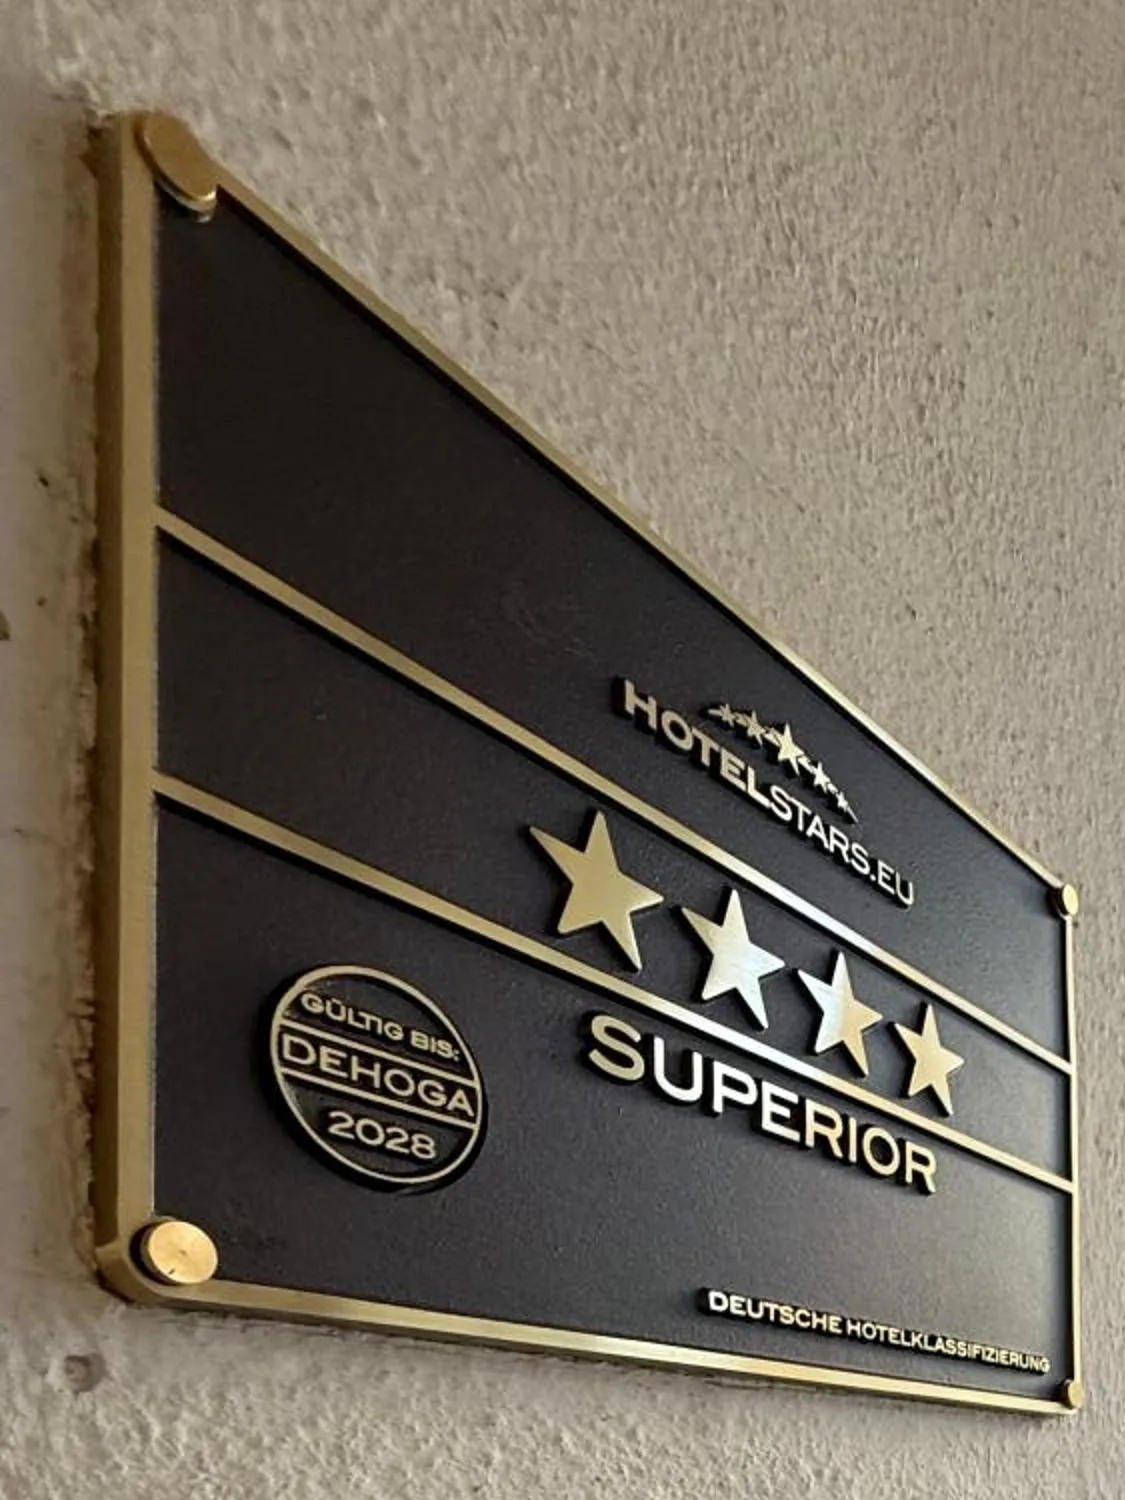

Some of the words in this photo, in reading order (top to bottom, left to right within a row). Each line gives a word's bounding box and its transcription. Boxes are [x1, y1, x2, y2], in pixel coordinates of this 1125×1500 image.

[623, 678, 915, 907] HOTELSTARS.EU
[300, 992, 405, 1041] GÜLTIG
[410, 1029, 461, 1062] BIS:
[281, 1033, 475, 1117] DEHOGA
[587, 1013, 938, 1193] SUPERIOR
[327, 1110, 437, 1160] 2028
[707, 1290, 843, 1336] DEUTSCHE
[845, 1318, 1052, 1374] HOTELKLASSIFIZIERUNG
